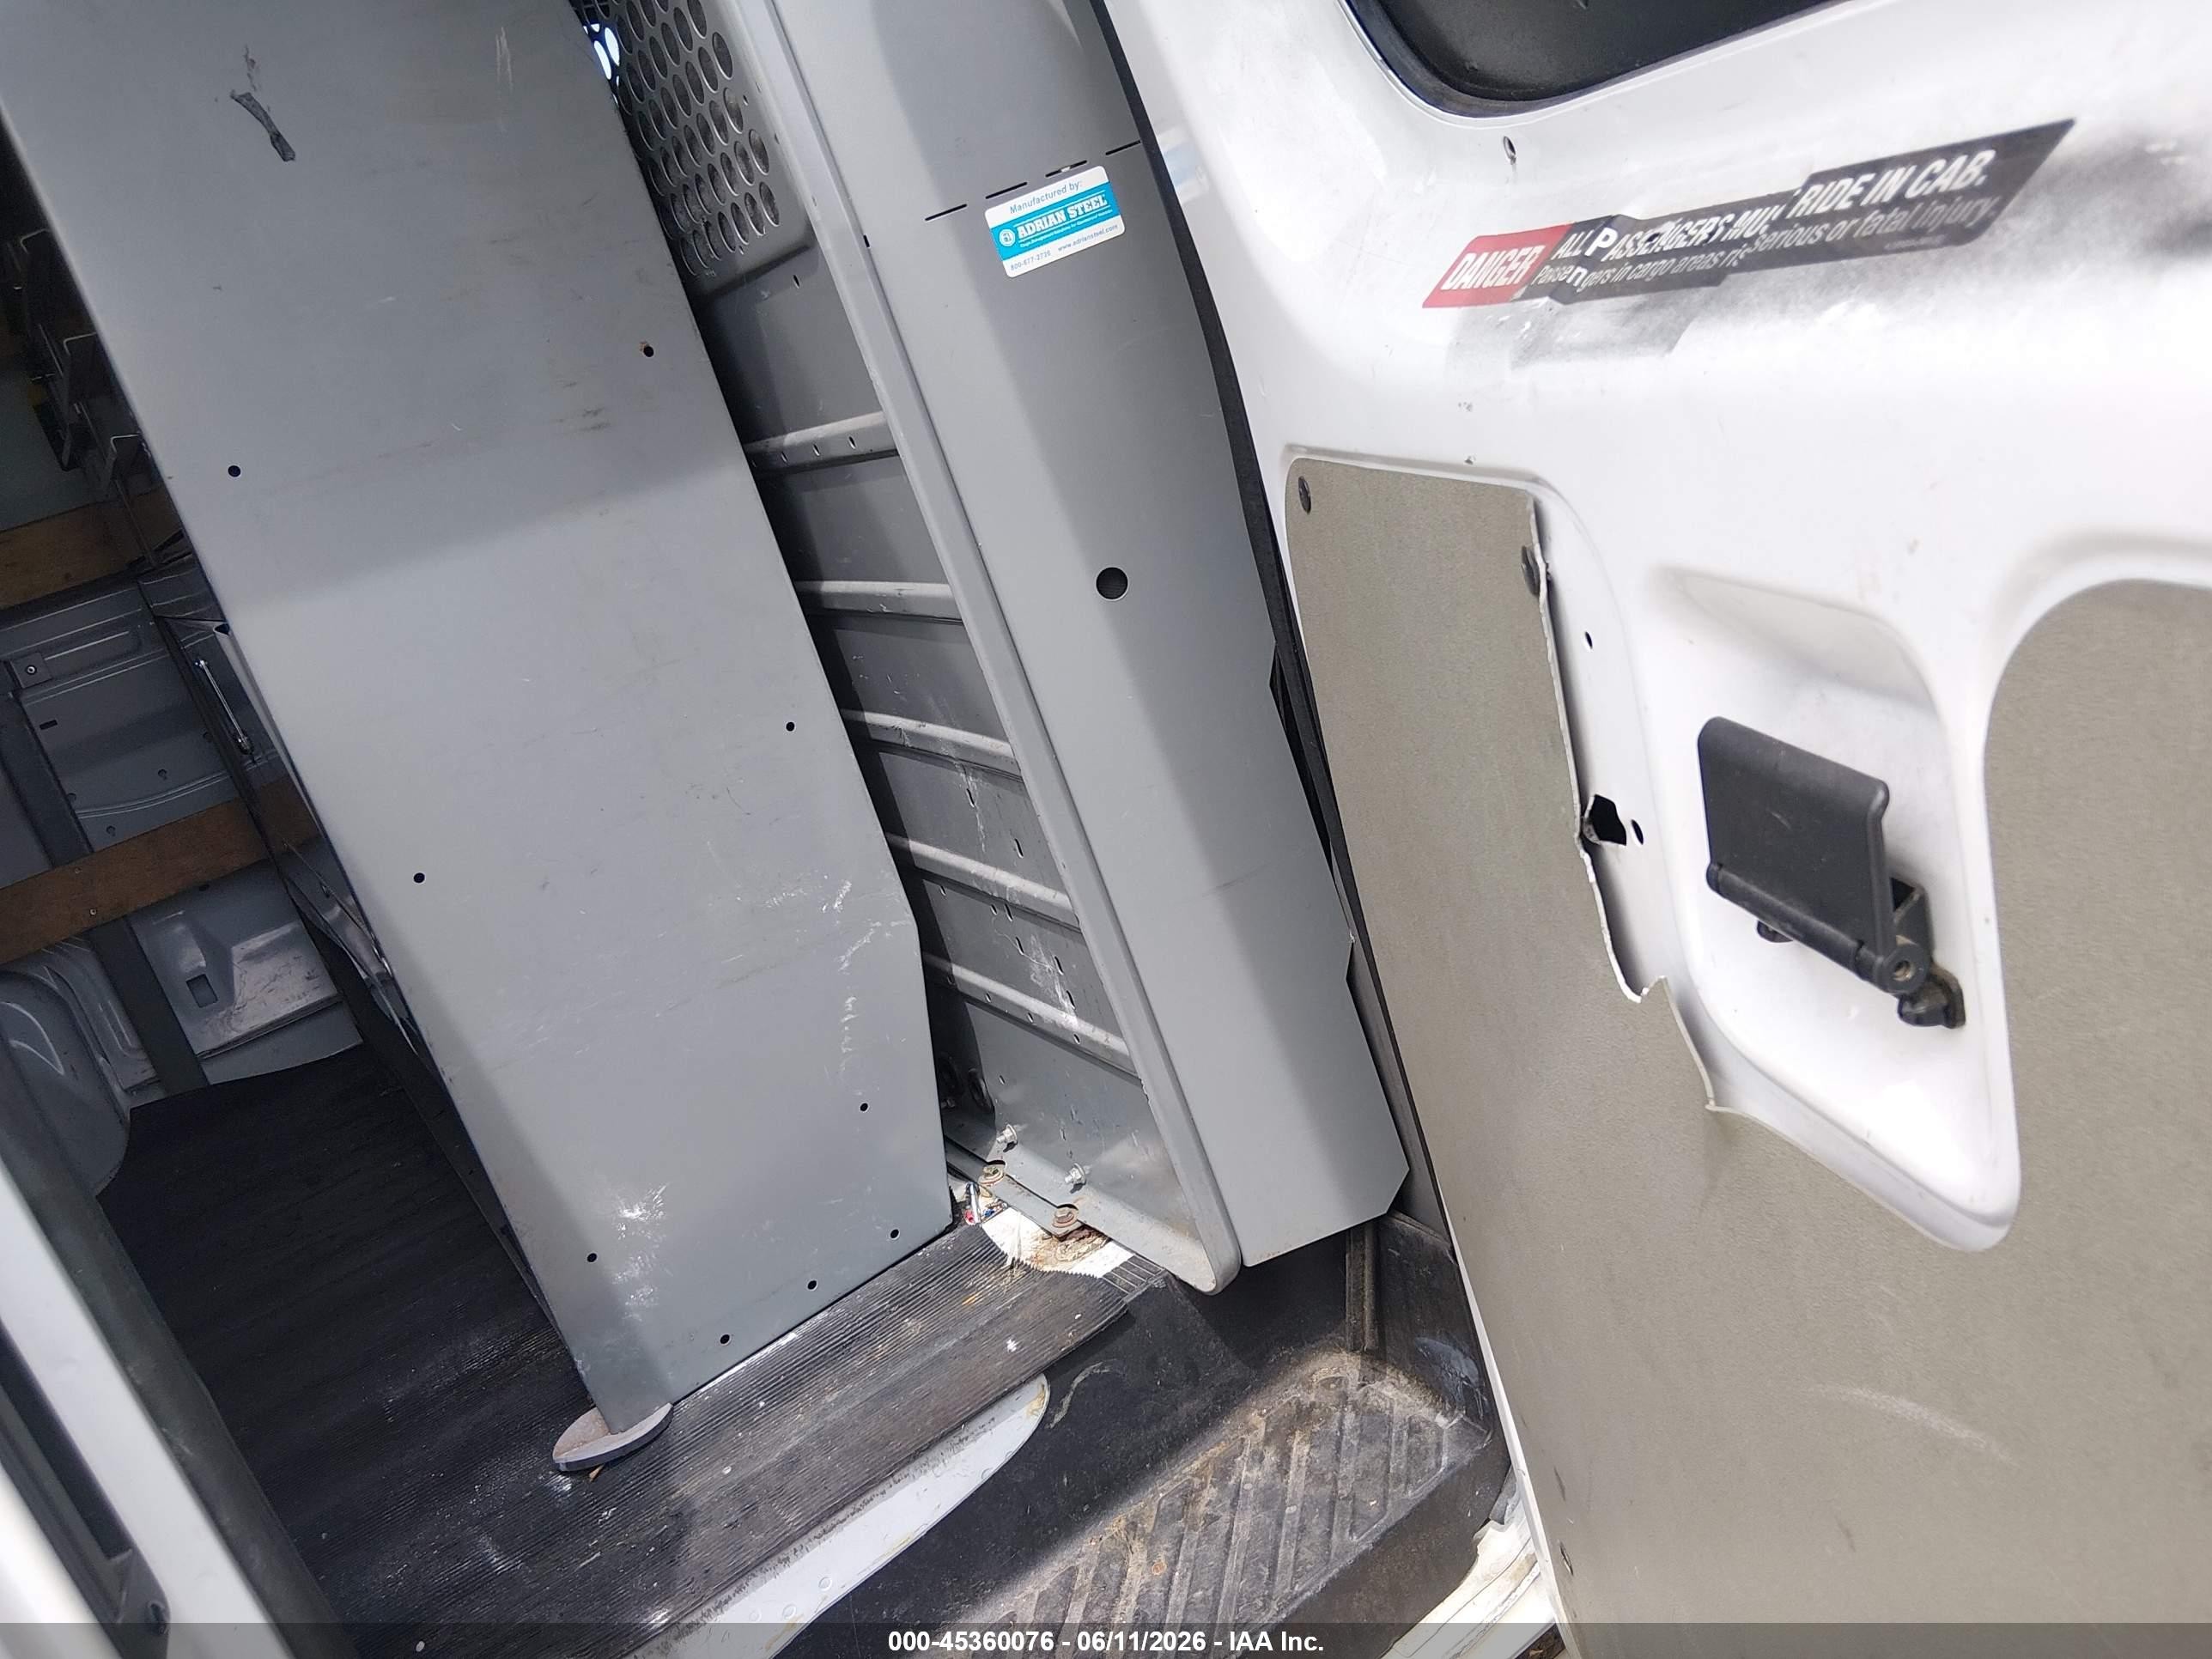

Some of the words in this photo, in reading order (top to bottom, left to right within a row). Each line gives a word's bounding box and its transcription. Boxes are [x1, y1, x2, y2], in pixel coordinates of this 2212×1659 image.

[1010, 185, 1067, 214] Manufactured
[1017, 209, 1066, 239] ADRIAN
[1066, 194, 1108, 222] STEEL
[1550, 228, 1595, 261] ALL
[1785, 173, 1876, 219] RIDE
[1860, 165, 1917, 207] IN
[1904, 149, 1997, 199] CAB.
[1609, 261, 1632, 283] in
[1626, 258, 1675, 283] cargo
[1670, 251, 1727, 276] areas
[1824, 216, 1862, 243] or
[1850, 204, 1920, 240] fatal
[1440, 245, 1546, 291] DANGER
